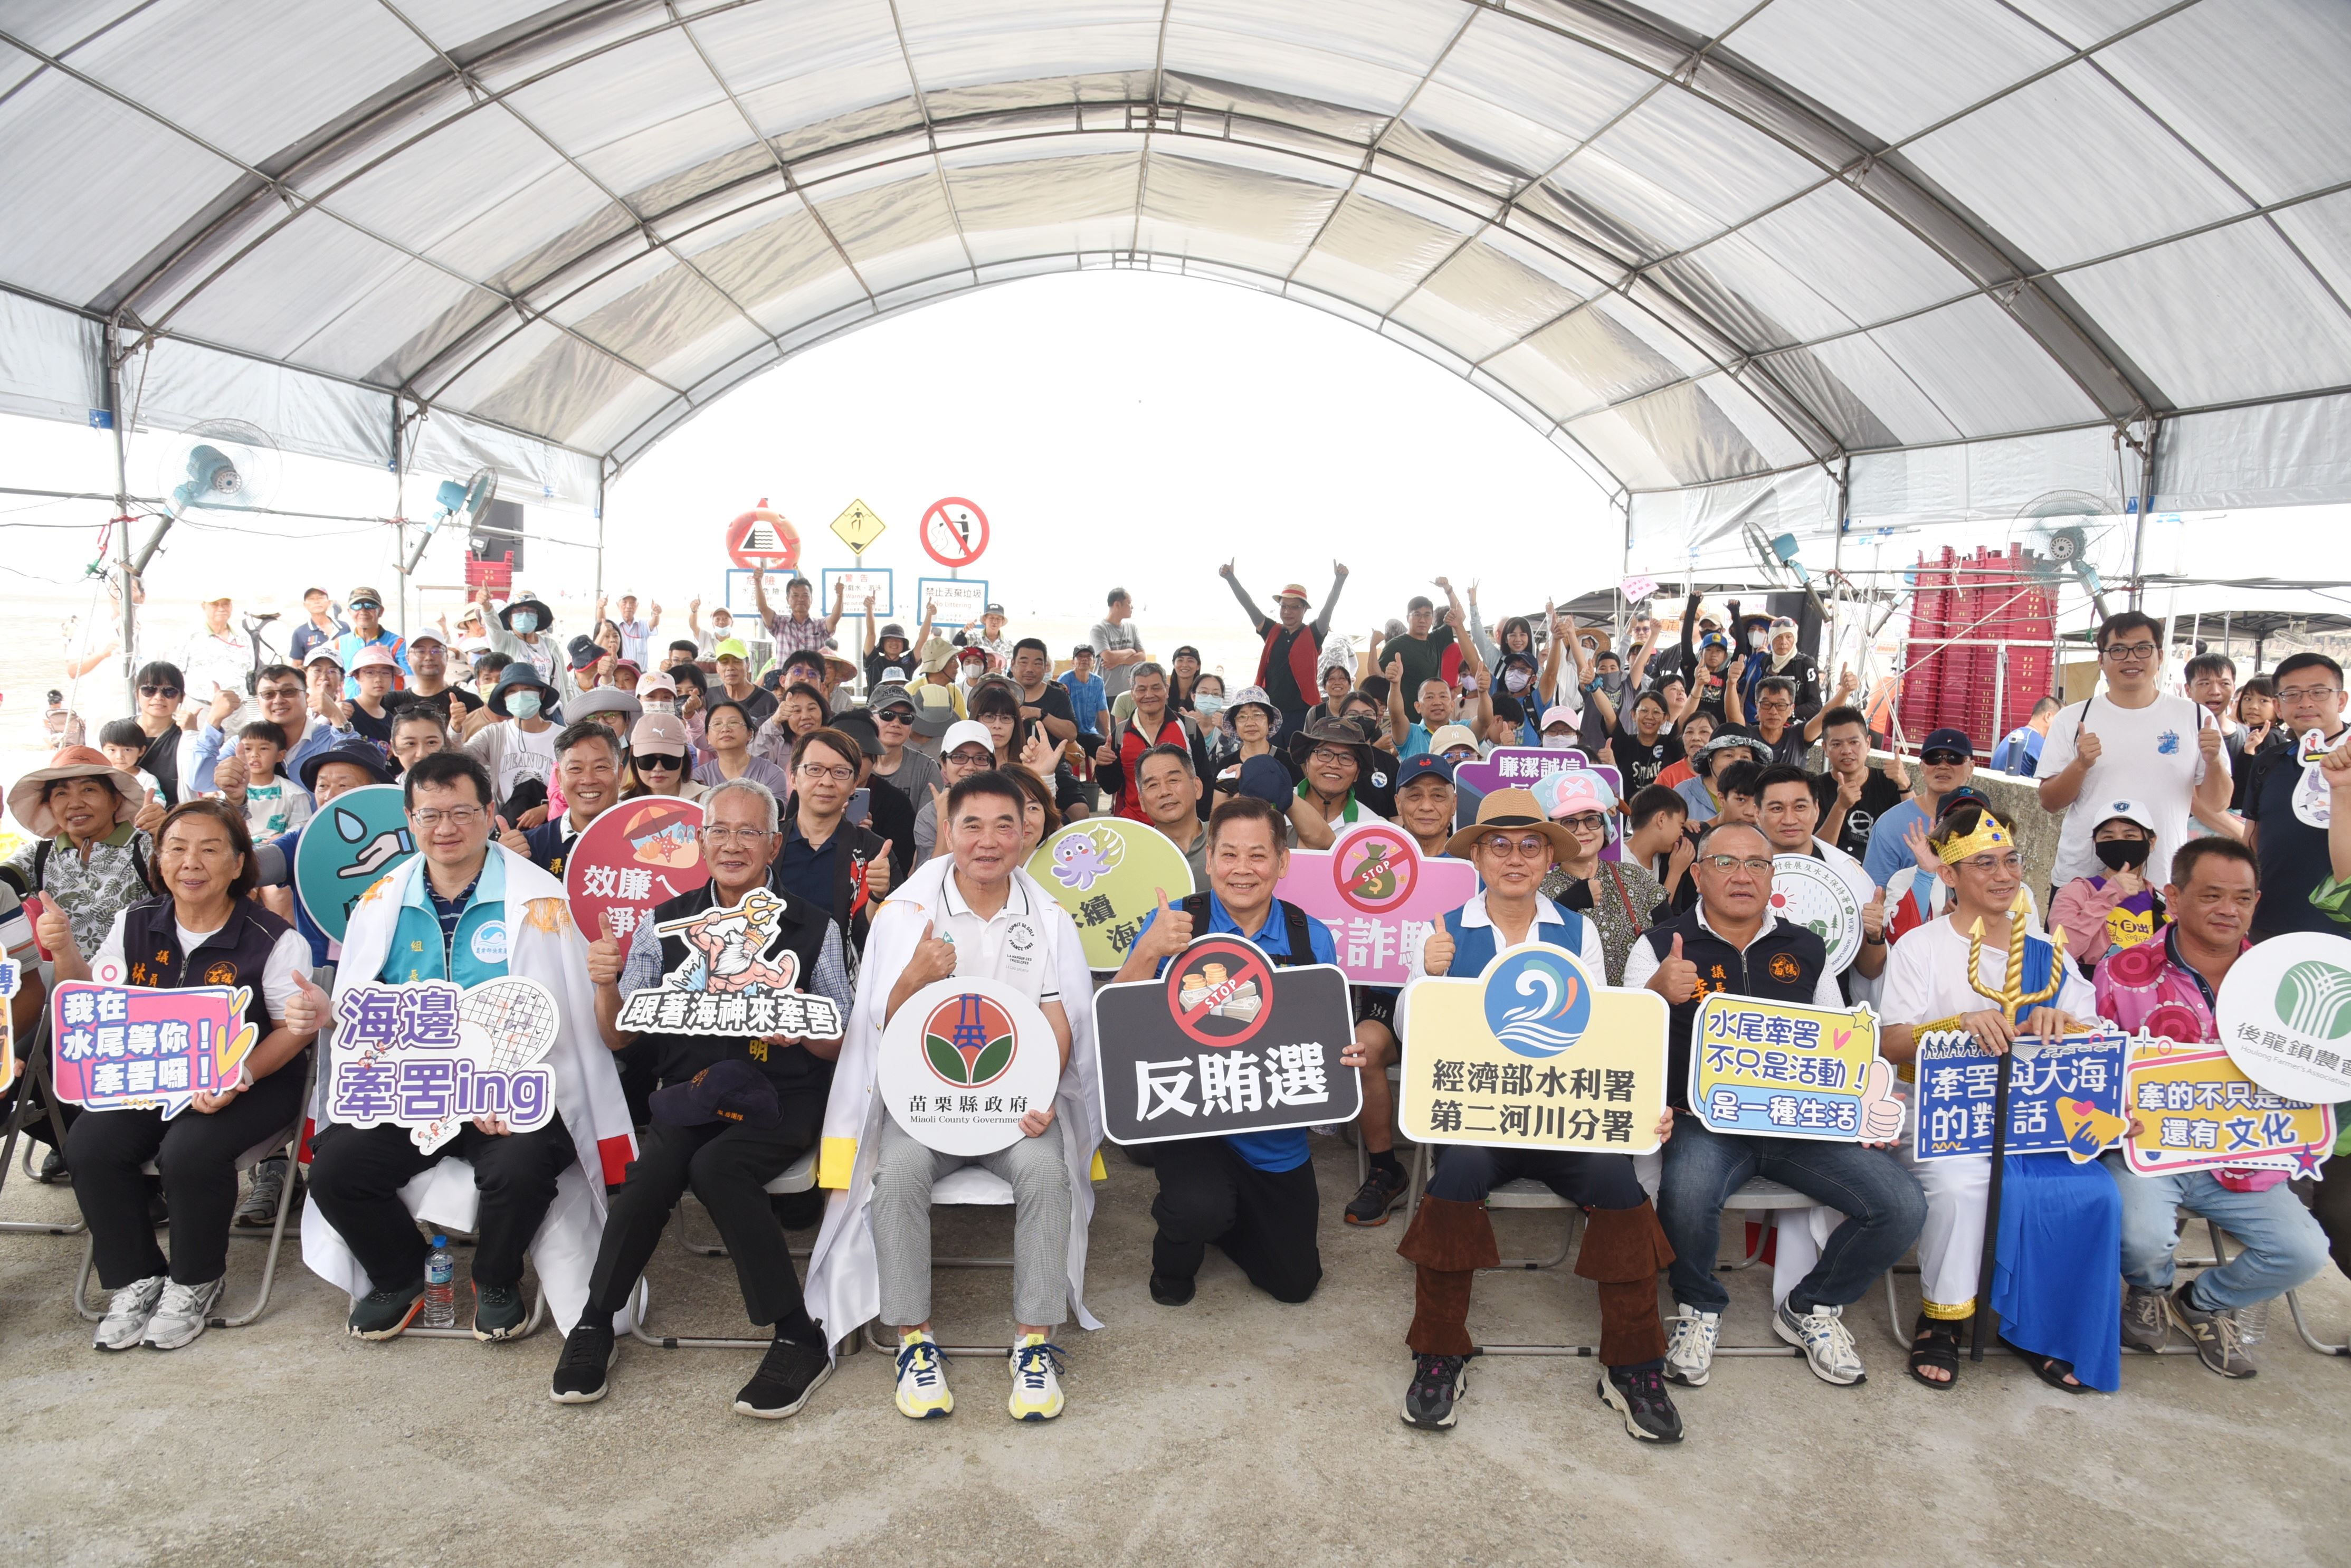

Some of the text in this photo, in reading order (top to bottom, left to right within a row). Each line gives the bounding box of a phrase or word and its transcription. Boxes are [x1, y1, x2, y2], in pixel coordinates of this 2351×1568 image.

[925, 587, 982, 598] 禁止丟棄垃圾
[502, 752, 554, 775] PEANUT
[1499, 756, 1581, 778] 廉潔誠信
[1362, 860, 1390, 882] STOP
[606, 906, 655, 938] 淨
[1008, 923, 1021, 933] ESPRIT
[1009, 939, 1023, 951] FRANCE
[132, 962, 146, 985] 林
[1710, 964, 1727, 993] 議長
[64, 990, 127, 1023] 我在
[1205, 977, 1238, 1010] STOP
[341, 988, 459, 1048] 海邊
[626, 991, 838, 1034] 跟著海神來牽罟
[1708, 1009, 1820, 1049] 水尾牽罟
[749, 1040, 768, 1062] 明
[2241, 1045, 2350, 1088] Houlong Farmer's Association
[1136, 1042, 1329, 1122] 反賄選
[1431, 1058, 1636, 1103] 經濟部水利署
[1931, 1057, 2108, 1101] 牽罟與大海
[909, 1095, 1028, 1113] 苗栗縣政府
[1430, 1098, 1635, 1143] 第二河川分署
[1711, 1091, 1857, 1130] 是一種生活
[1931, 1100, 2048, 1142] 的對話
[2161, 1113, 2299, 1152] 還有文化
